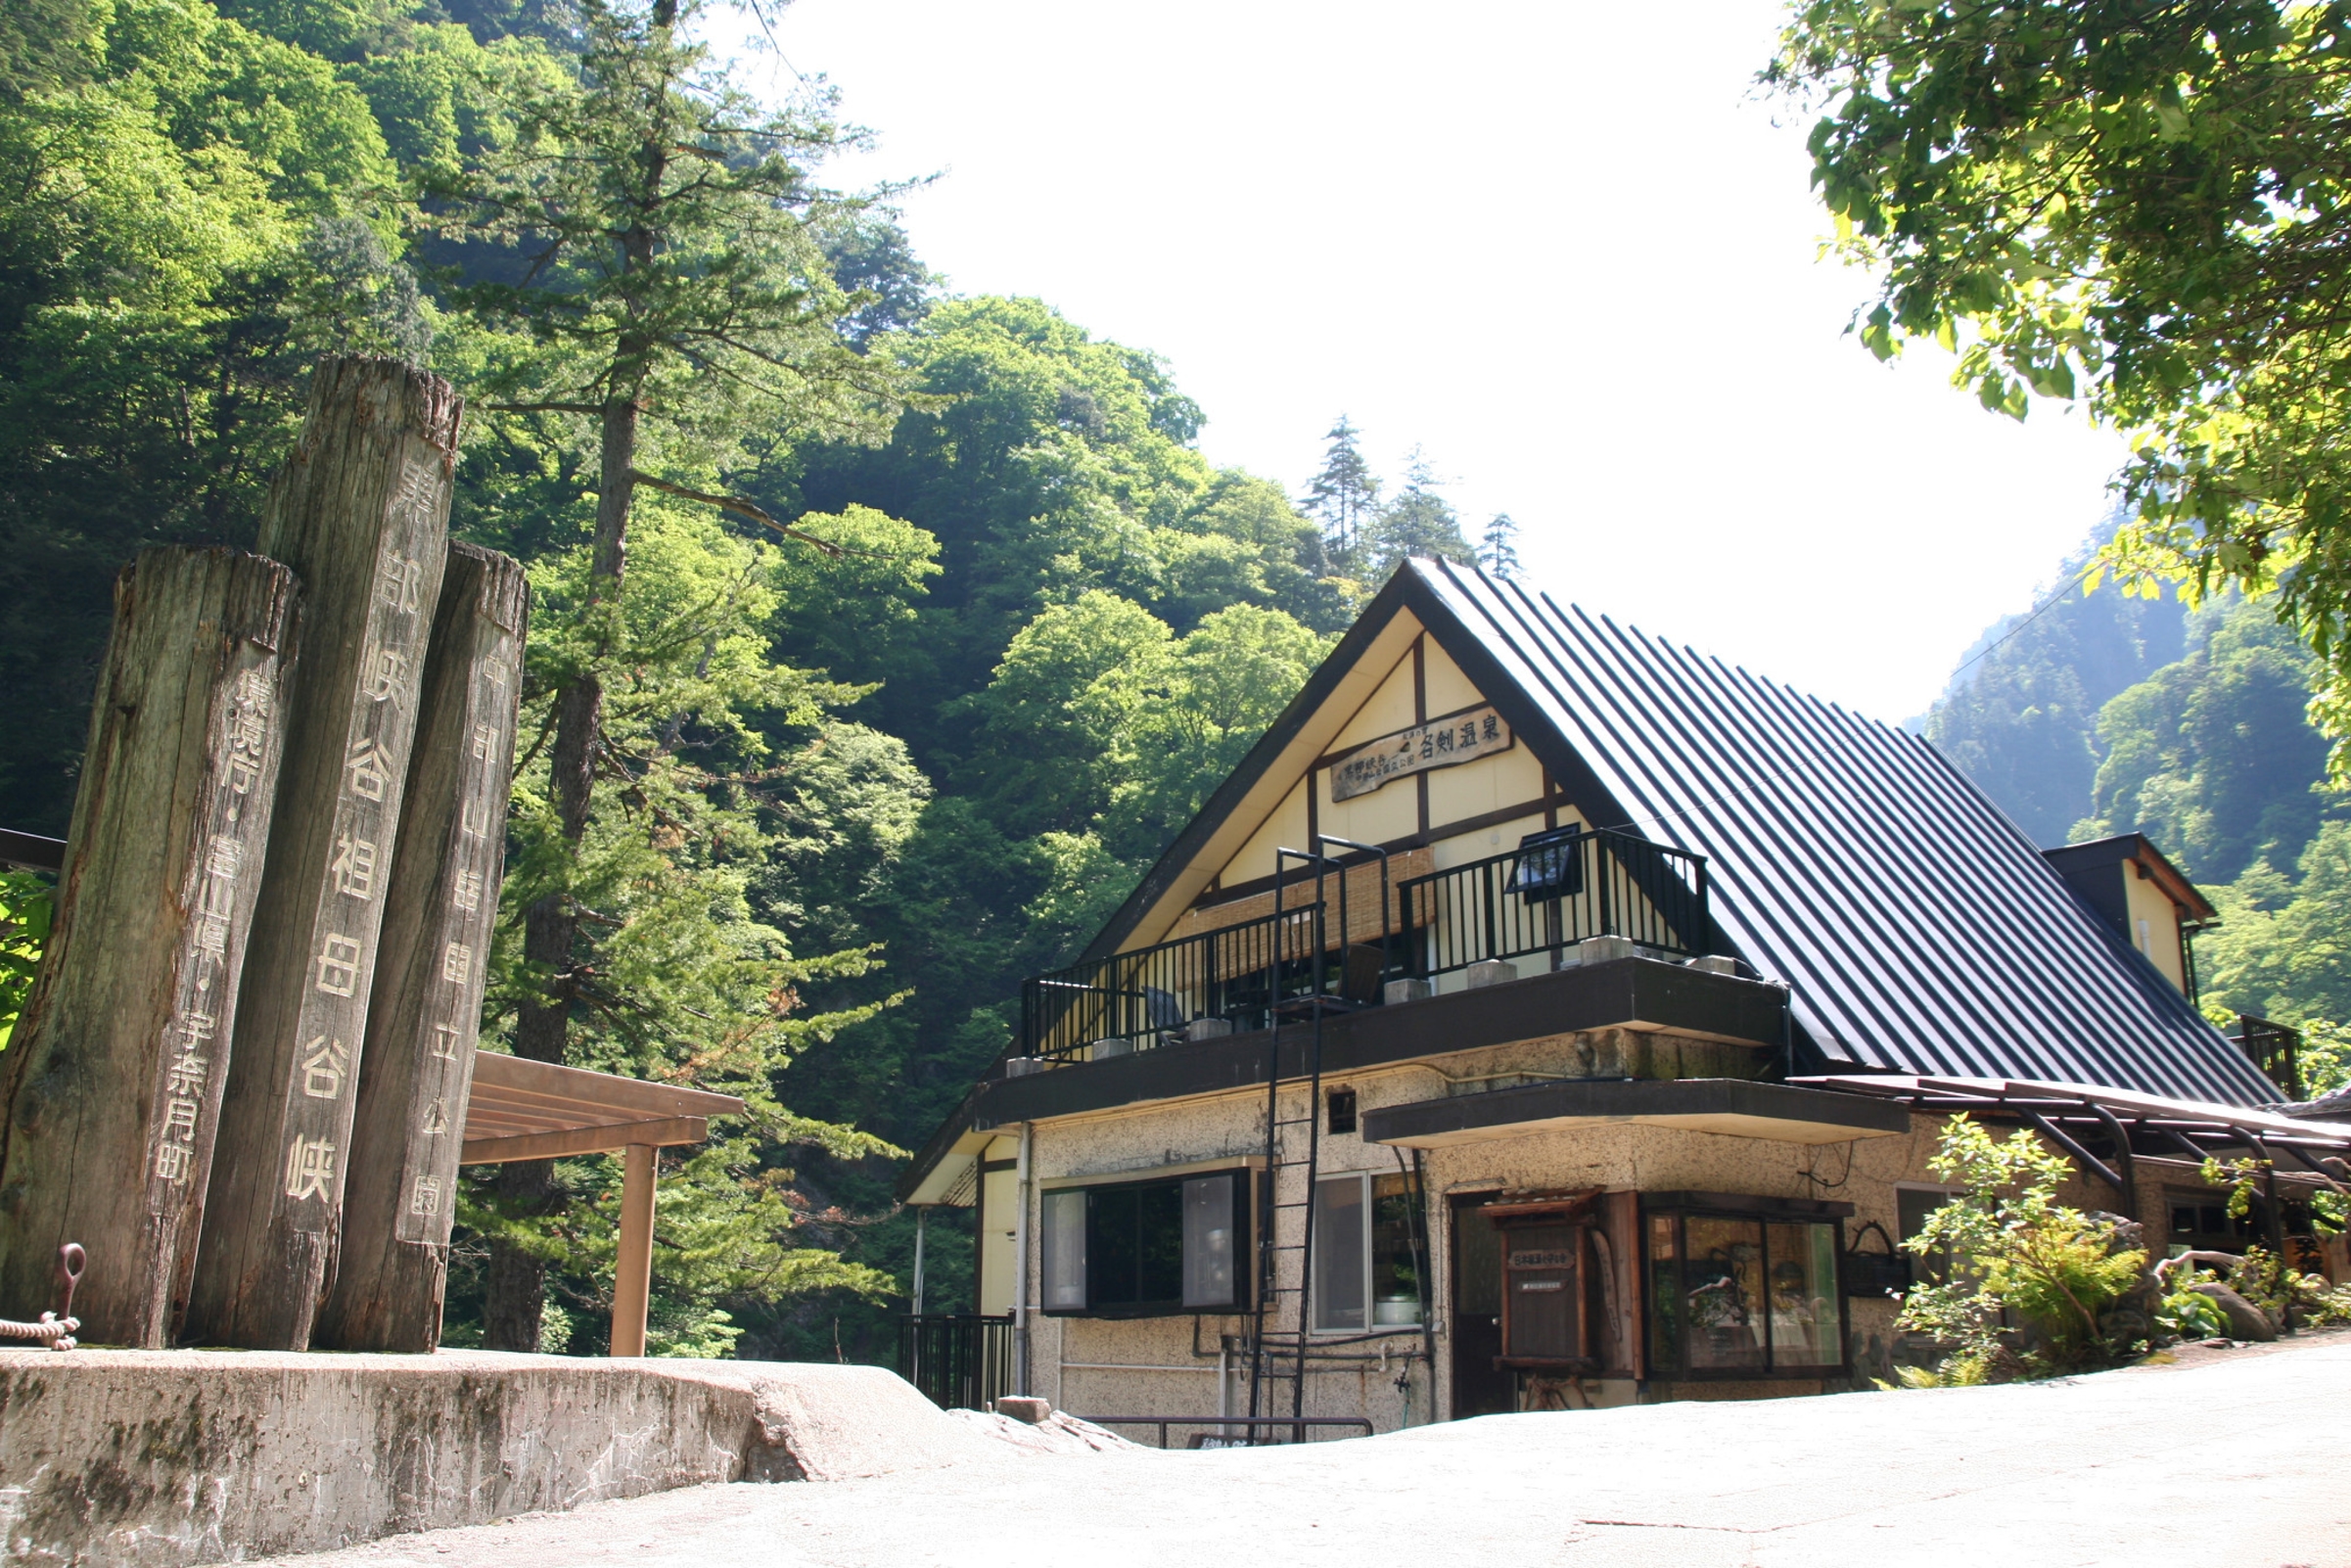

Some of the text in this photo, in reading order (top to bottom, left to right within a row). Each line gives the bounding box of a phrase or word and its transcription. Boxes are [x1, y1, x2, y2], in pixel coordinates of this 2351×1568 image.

[1419, 714, 1499, 760] 名剣温泉
[412, 653, 507, 1216] 中部山岳国立公園
